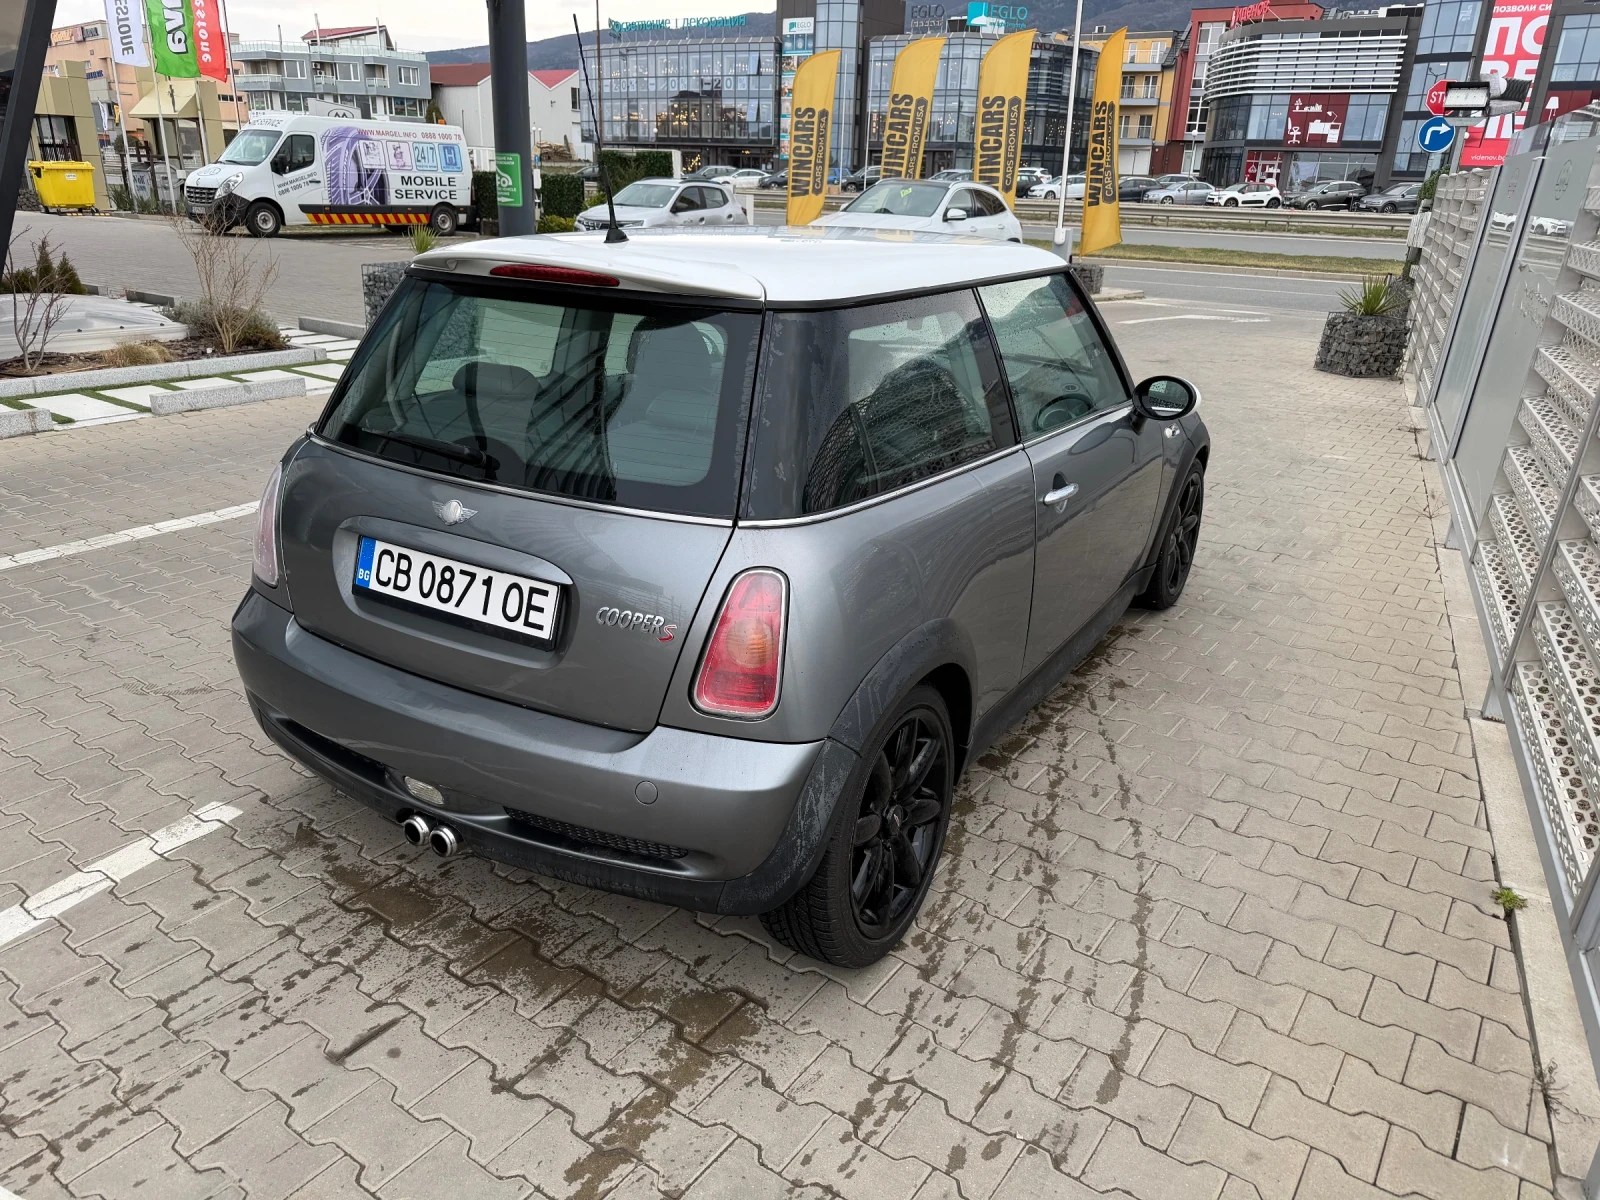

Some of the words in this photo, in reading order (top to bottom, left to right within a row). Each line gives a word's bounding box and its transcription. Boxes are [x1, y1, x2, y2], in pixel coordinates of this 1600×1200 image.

[911, 4, 945, 18] EGLO
[990, 5, 1028, 20] EGLO
[1493, 4, 1536, 13] ПОЗВОЛИ
[682, 14, 746, 30] декорация
[1010, 105, 1018, 125] USA
[911, 127, 921, 154] FROM
[916, 105, 924, 124] USA
[791, 107, 816, 197] WINCARS
[816, 138, 824, 163] FROM
[1007, 129, 1016, 157] FROM
[1088, 101, 1108, 207] WINCARS
[401, 175, 457, 187] MOBILE
[1005, 160, 1013, 186] CARS
[1104, 170, 1113, 196] CARS
[394, 189, 458, 200] SERVICE
[358, 568, 370, 581] BG
[595, 606, 666, 636] COOPER
